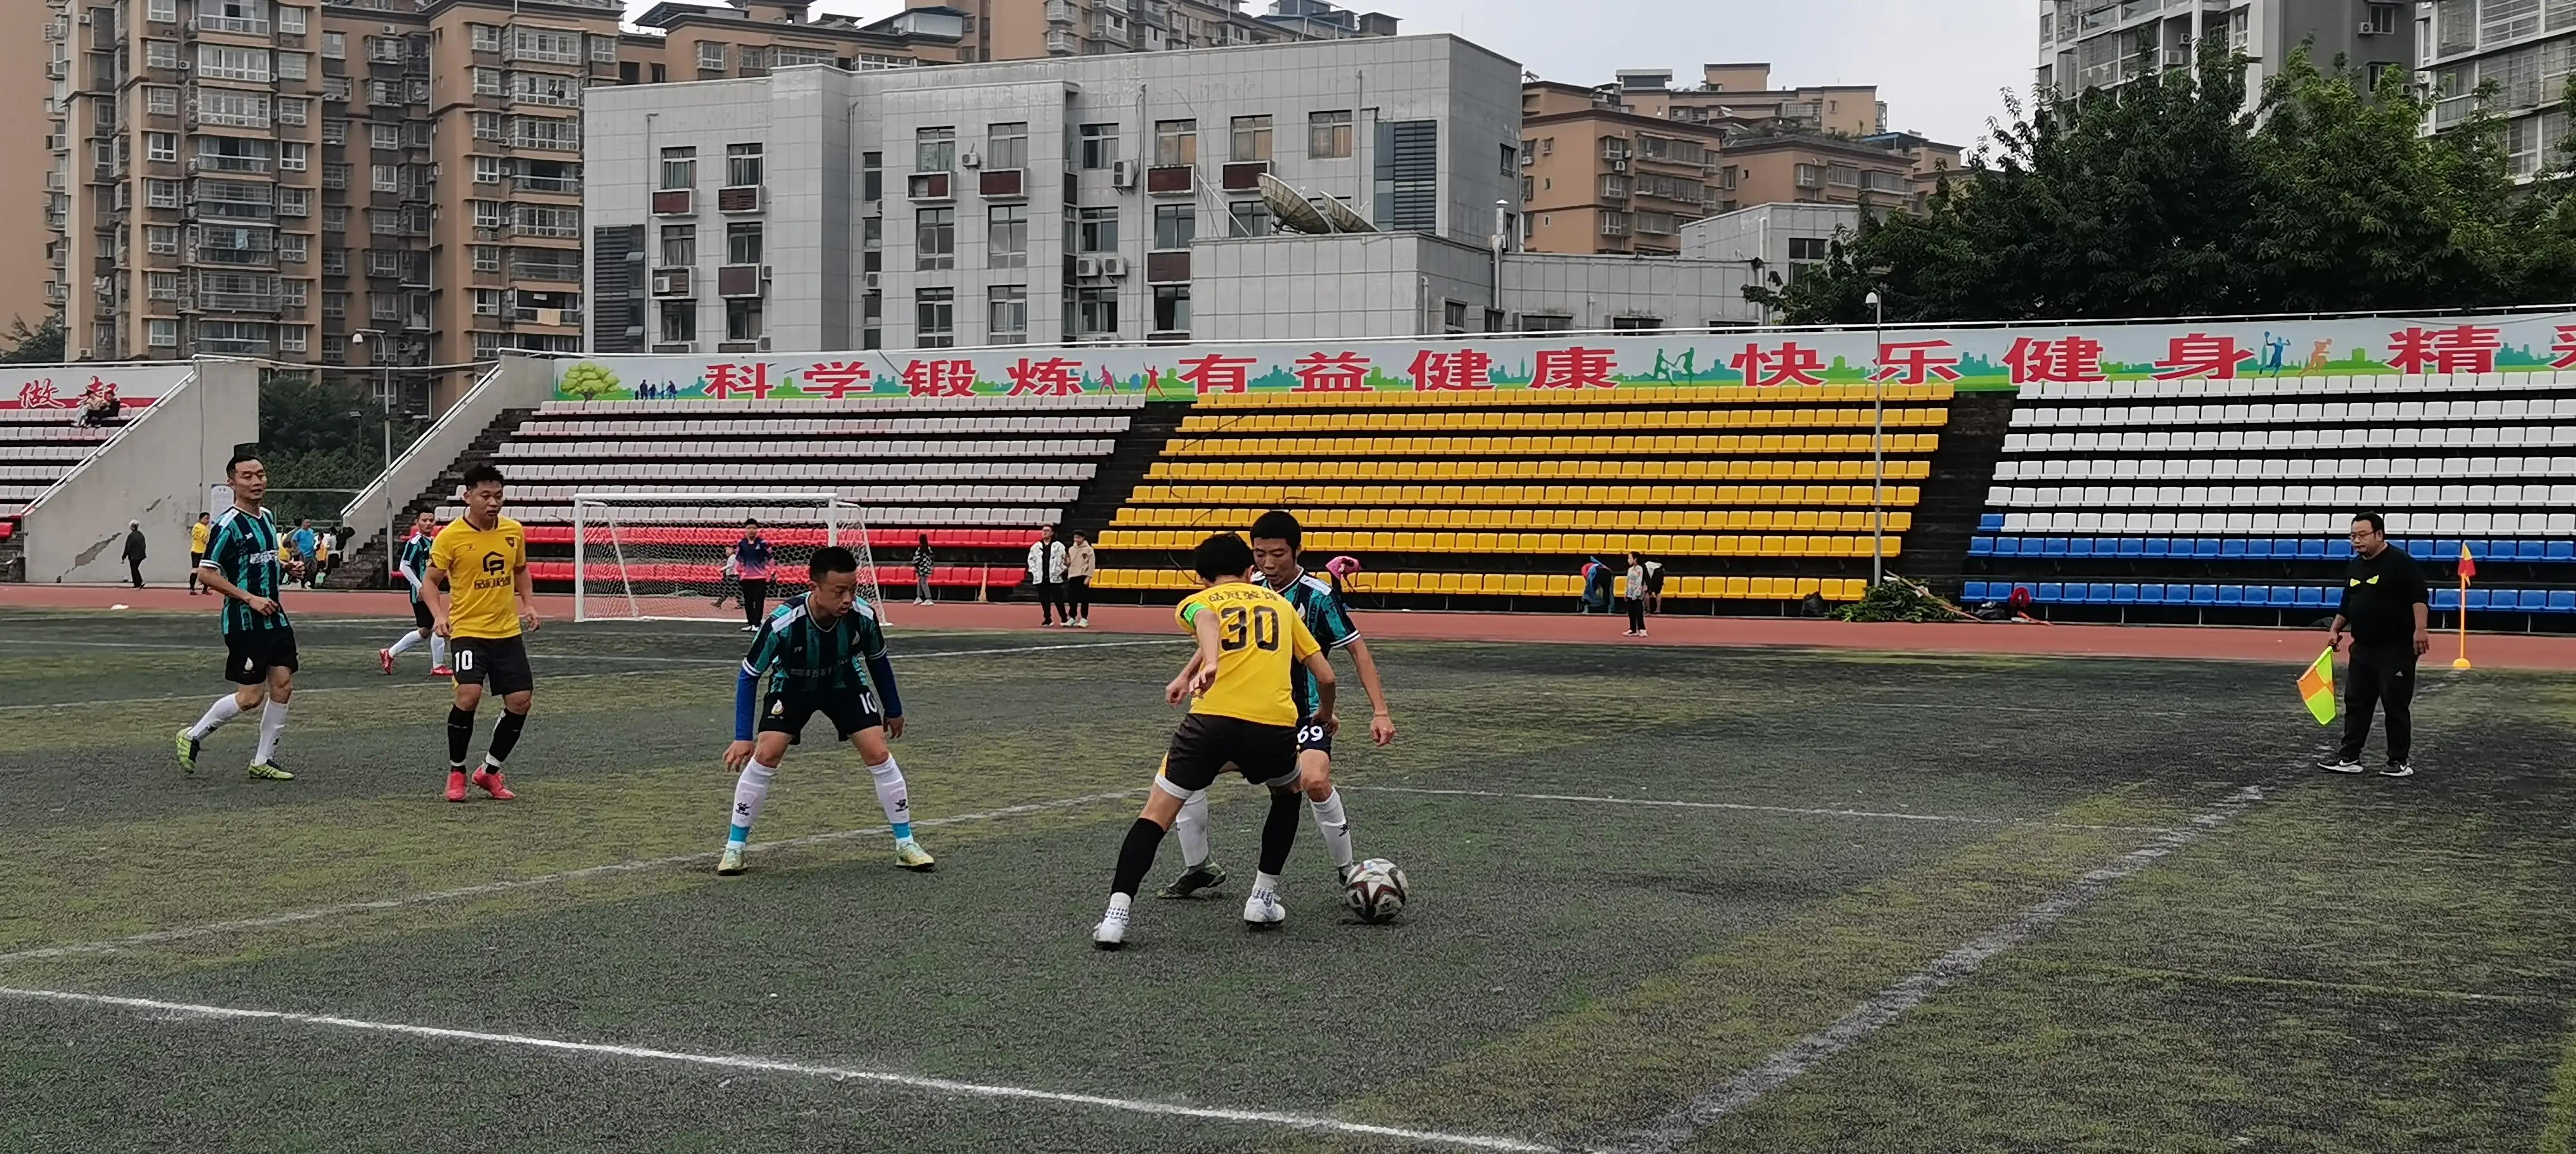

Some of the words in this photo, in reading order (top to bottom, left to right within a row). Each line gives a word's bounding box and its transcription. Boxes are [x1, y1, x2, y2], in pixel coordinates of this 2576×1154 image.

[705, 357, 1083, 399] 科学锻炼
[1178, 346, 1620, 393] 有益健康
[1730, 333, 2255, 386] 快乐健身
[1221, 606, 1278, 651] 30
[455, 650, 473, 673] 10
[859, 692, 878, 715] 10
[1298, 726, 1323, 744] 69
